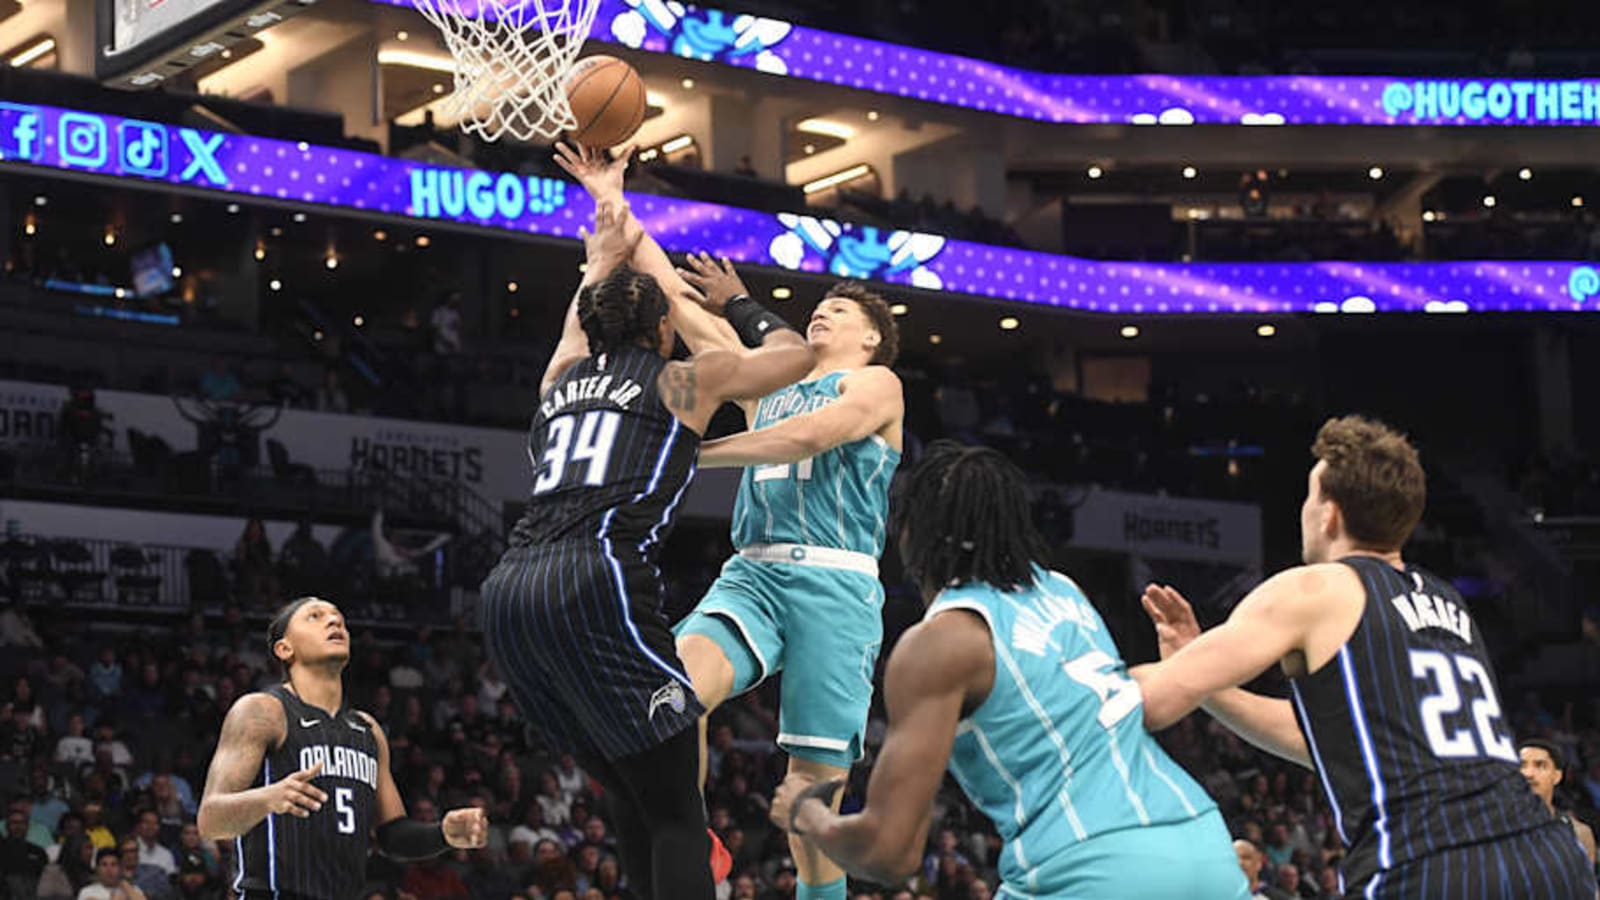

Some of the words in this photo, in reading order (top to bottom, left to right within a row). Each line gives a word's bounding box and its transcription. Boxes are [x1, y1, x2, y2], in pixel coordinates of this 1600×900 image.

[541, 375, 613, 419] CARTER
[350, 436, 484, 483] HORNETS
[532, 409, 622, 496] 34
[1061, 650, 1142, 731] 5
[1407, 648, 1520, 764] 22
[299, 745, 378, 790] ORLANDO
[335, 787, 356, 834] 5
